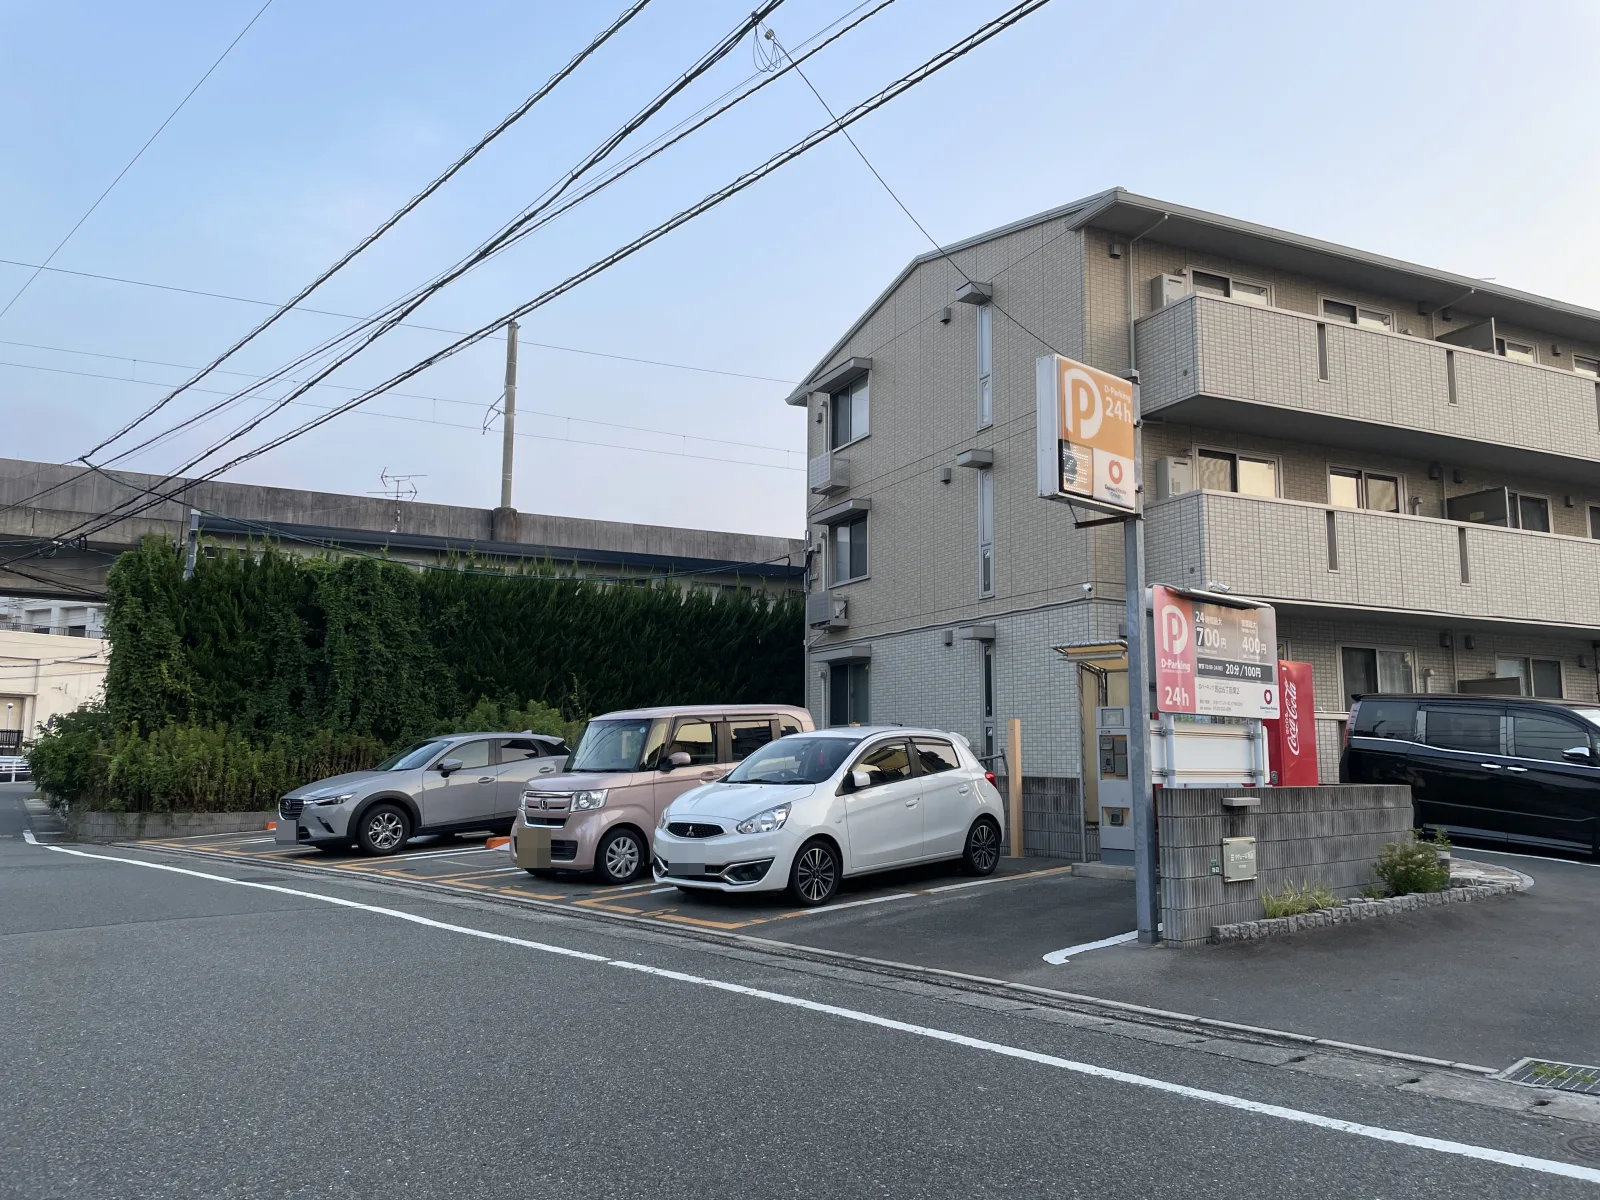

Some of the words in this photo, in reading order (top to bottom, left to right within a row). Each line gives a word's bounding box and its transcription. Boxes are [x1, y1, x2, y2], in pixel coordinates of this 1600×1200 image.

[1105, 396, 1132, 424] 24h
[1196, 626, 1227, 650] 700円
[1242, 636, 1267, 655] 400円
[1160, 658, 1191, 673] D-Parking
[1164, 685, 1190, 707] 24h
[1284, 676, 1299, 756] Coca-Cola
